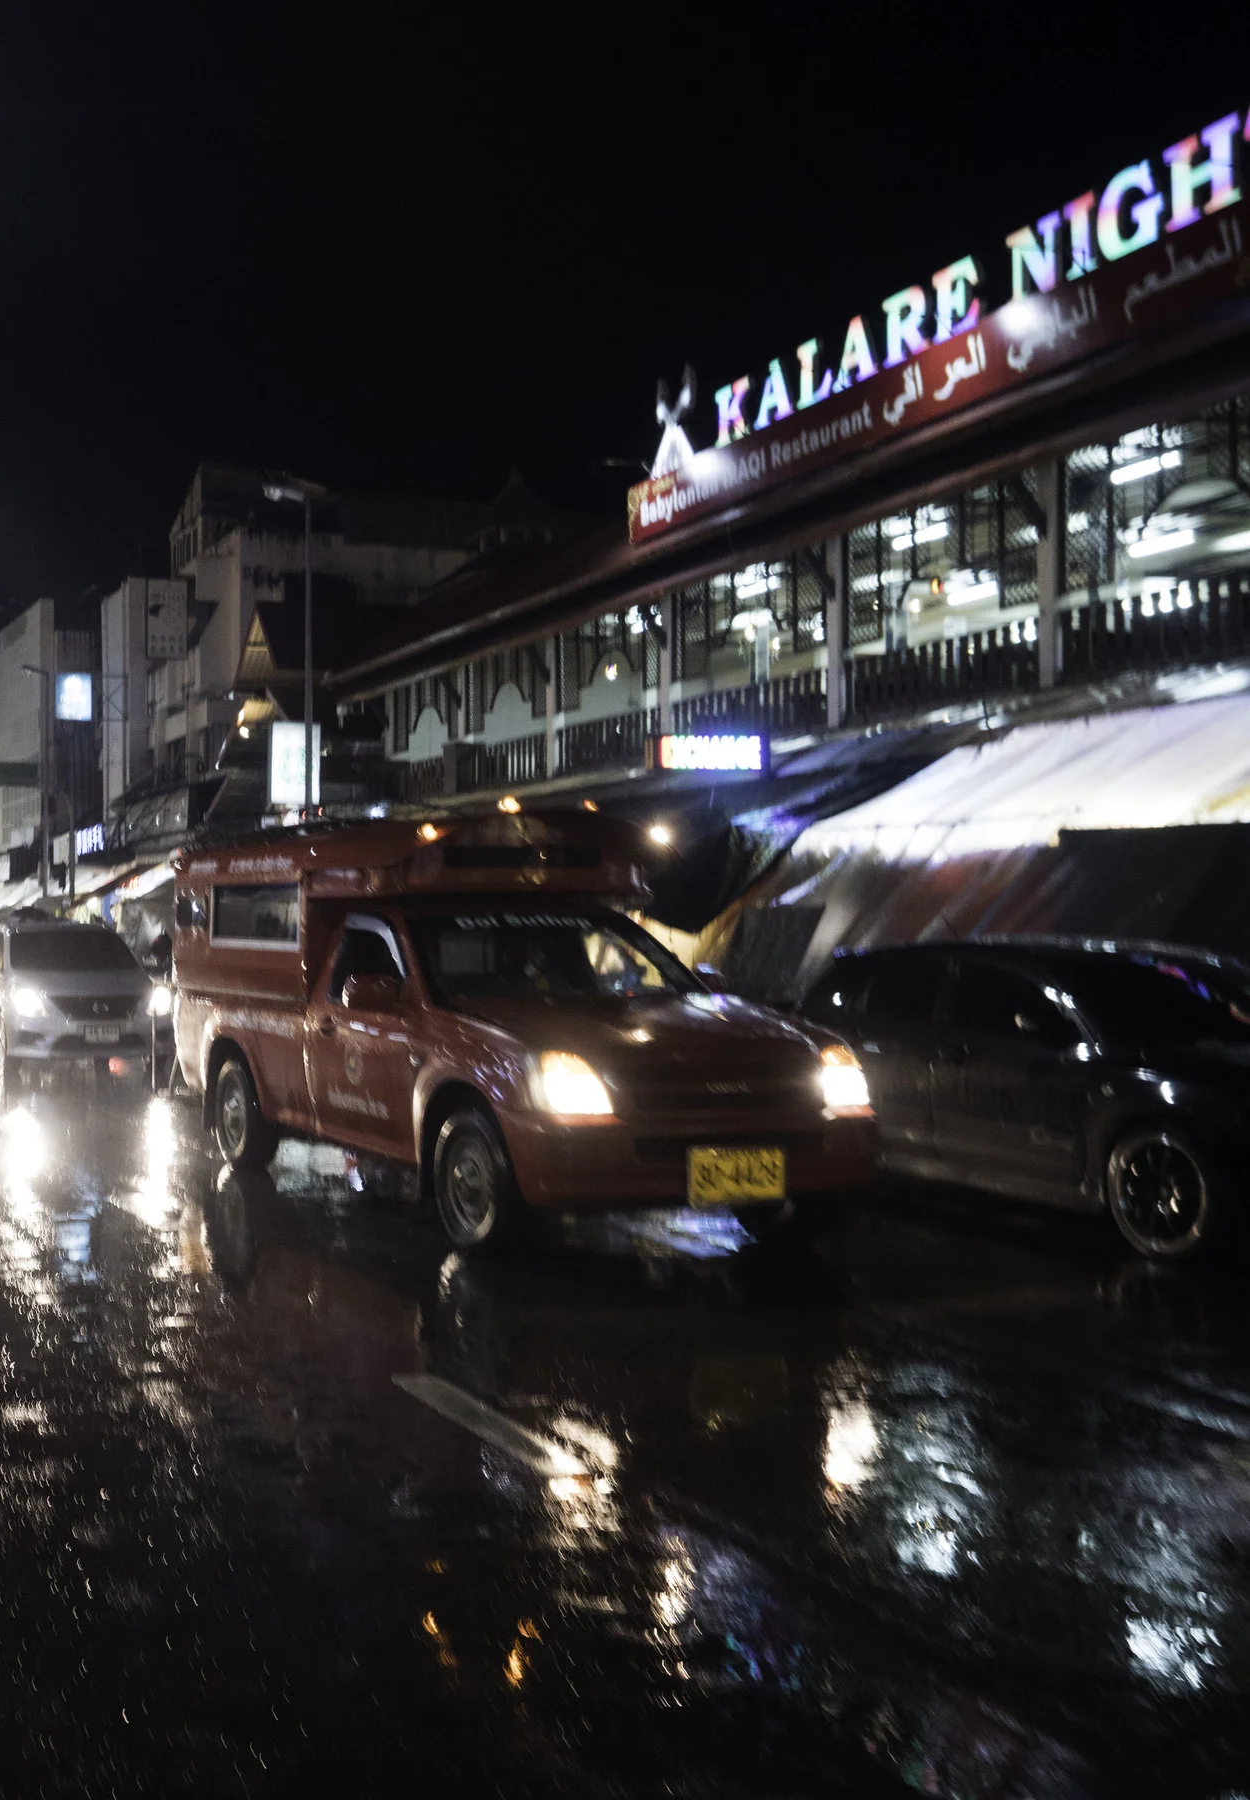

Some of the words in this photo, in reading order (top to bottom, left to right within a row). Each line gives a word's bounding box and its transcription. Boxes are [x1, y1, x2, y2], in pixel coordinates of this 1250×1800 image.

[714, 254, 982, 448] KALARE
[1005, 104, 1250, 304] NIGH
[770, 401, 874, 469] Restaurant
